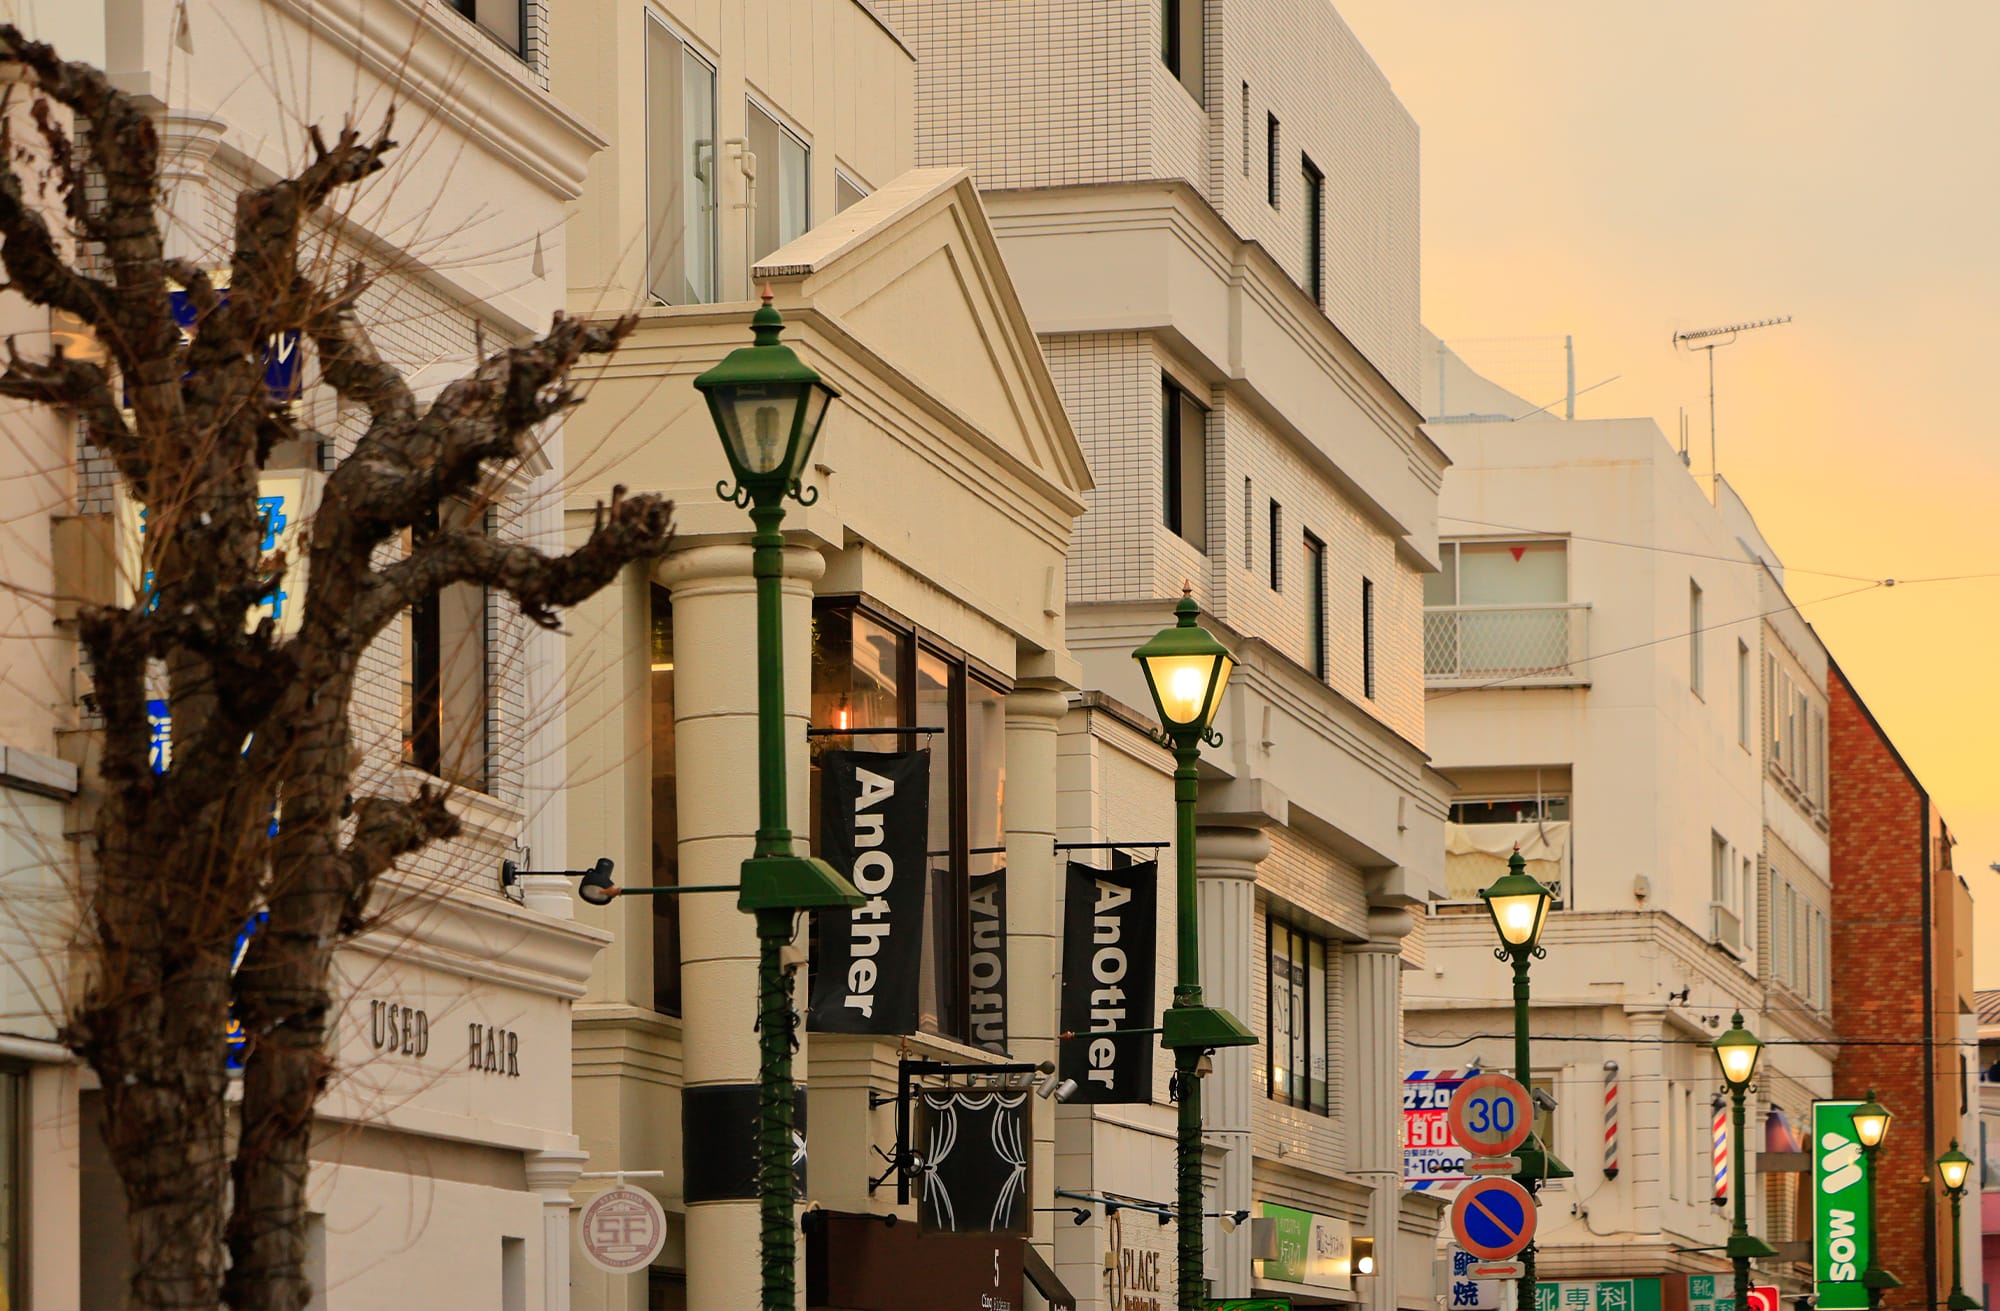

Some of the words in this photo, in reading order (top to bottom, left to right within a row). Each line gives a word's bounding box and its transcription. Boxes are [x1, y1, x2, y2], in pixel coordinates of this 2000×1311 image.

[371, 1000, 429, 1058] USED
[468, 1022, 520, 1077] HAIR
[1469, 1097, 1515, 1133] 30
[597, 1218, 646, 1244] SF
[1829, 1208, 1856, 1283] MOS
[994, 1248, 1000, 1287] 5
[1124, 1248, 1160, 1292] PLACE
